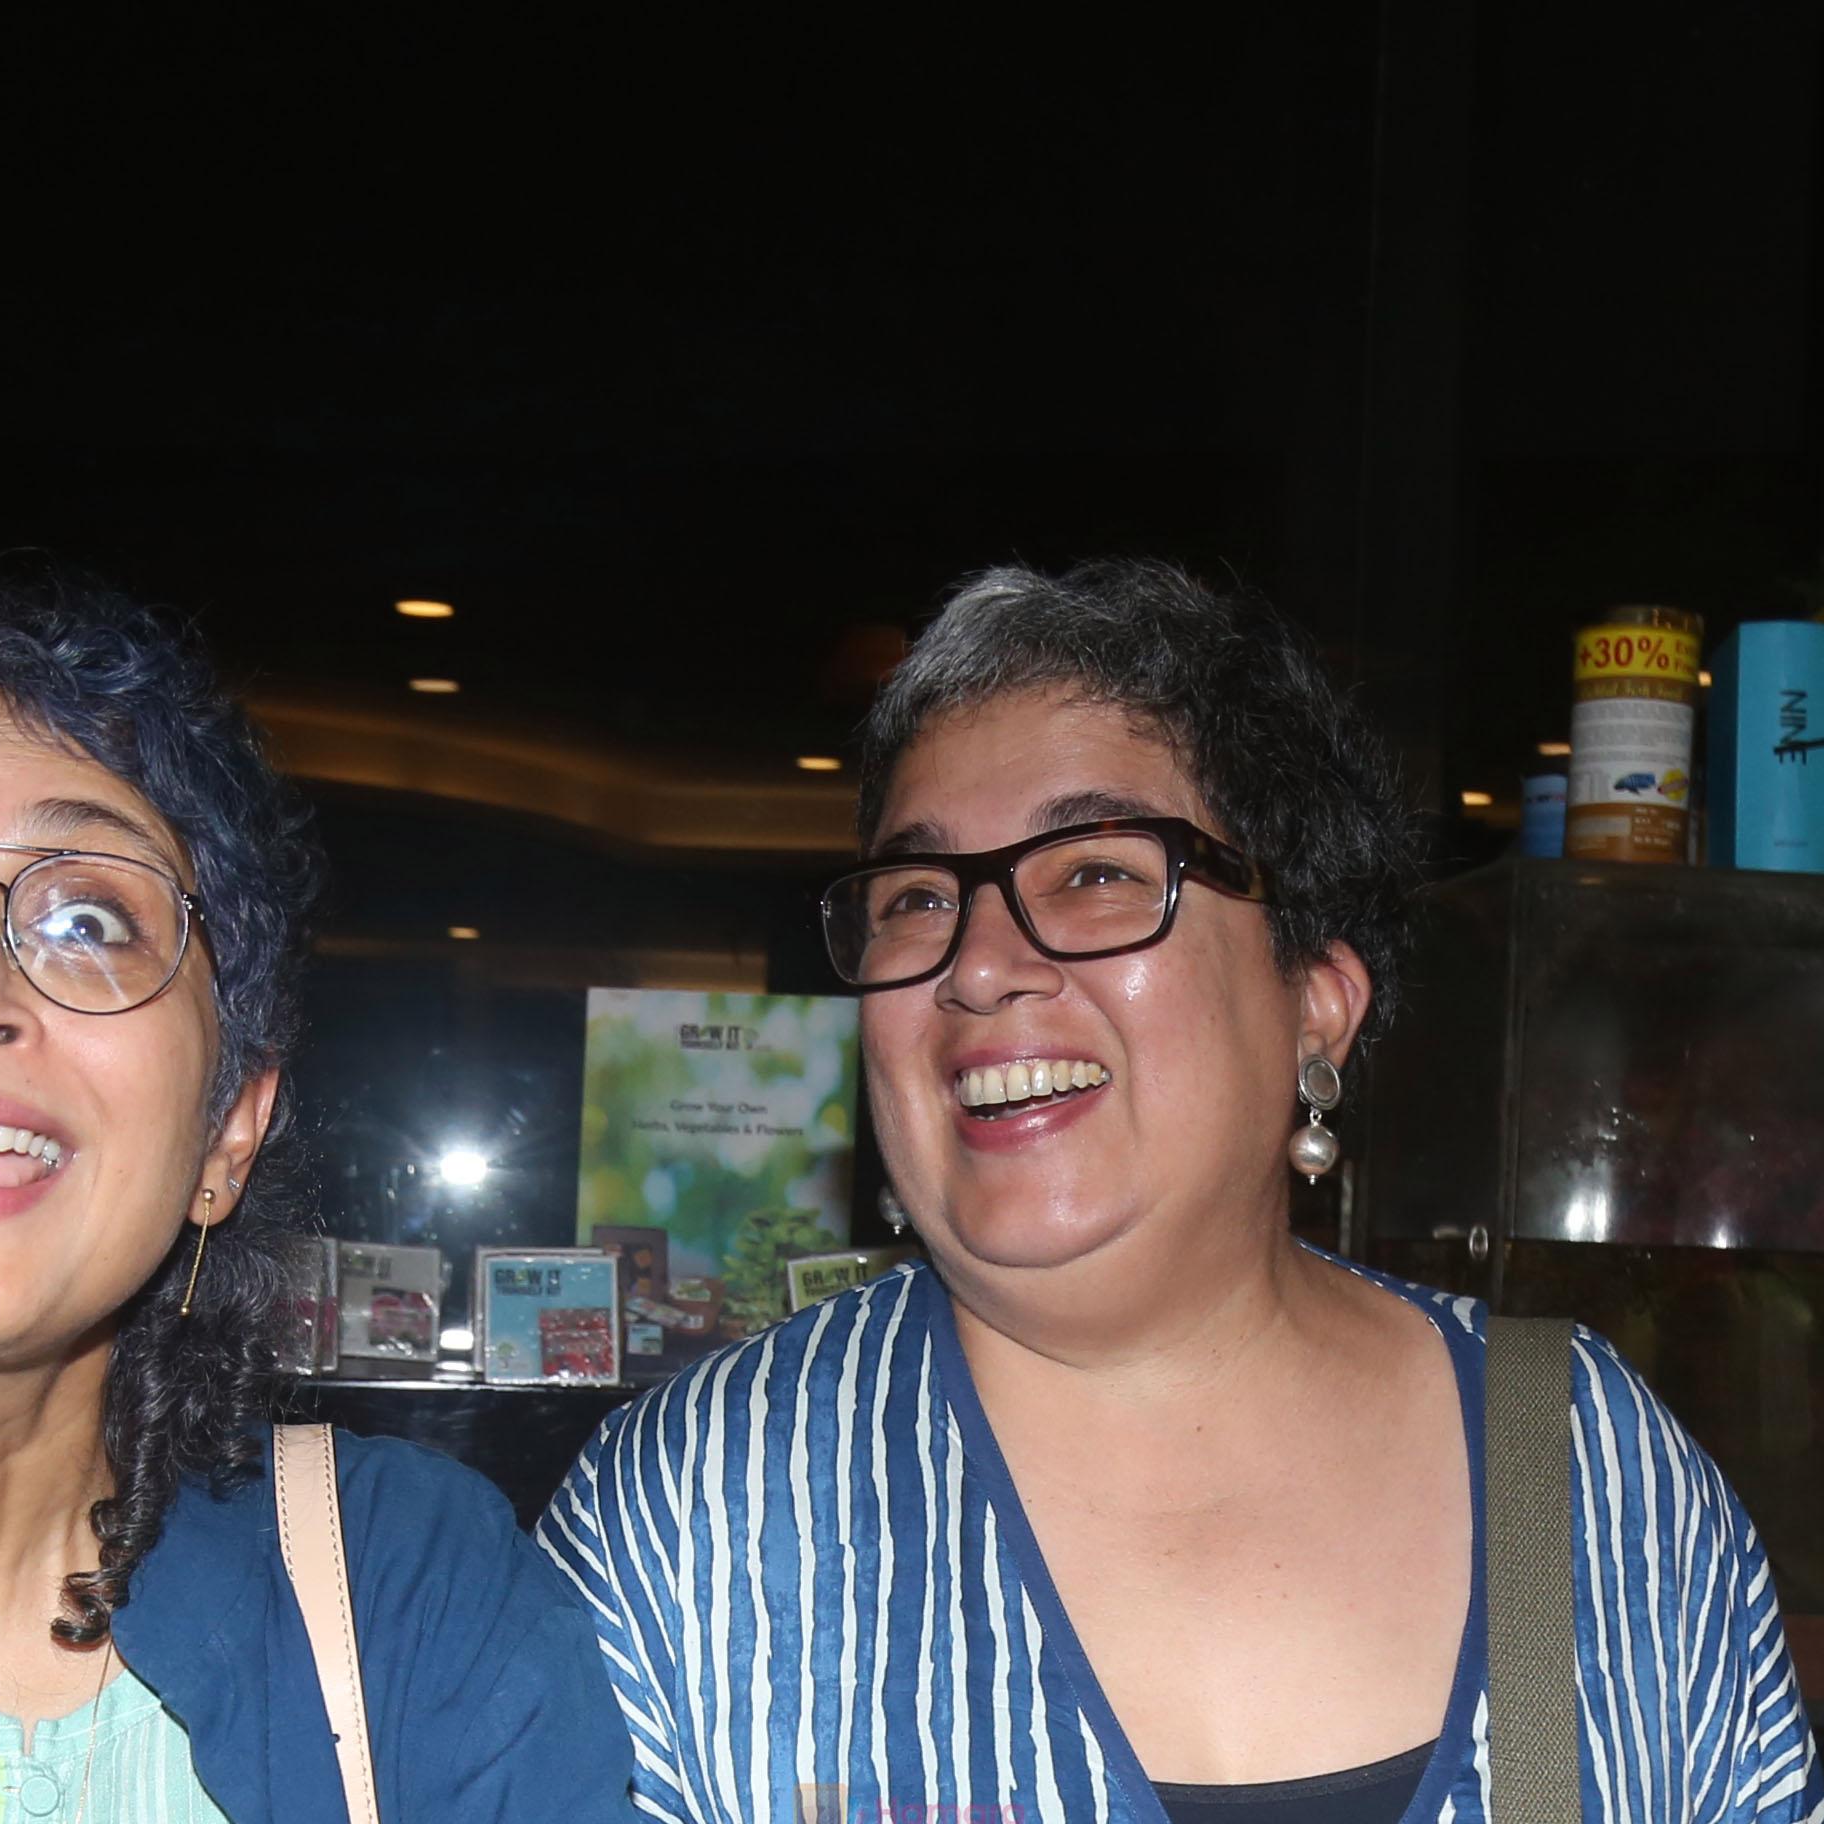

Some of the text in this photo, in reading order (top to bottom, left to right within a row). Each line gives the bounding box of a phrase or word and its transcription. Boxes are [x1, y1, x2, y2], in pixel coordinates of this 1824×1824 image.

[1579, 636, 1670, 671] +30%
[1778, 690, 1808, 765] NINE
[670, 1099, 768, 1114] Grow Your Own
[673, 1121, 740, 1136] Vegetables
[743, 1125, 753, 1135] &
[756, 1123, 804, 1136] Flowers
